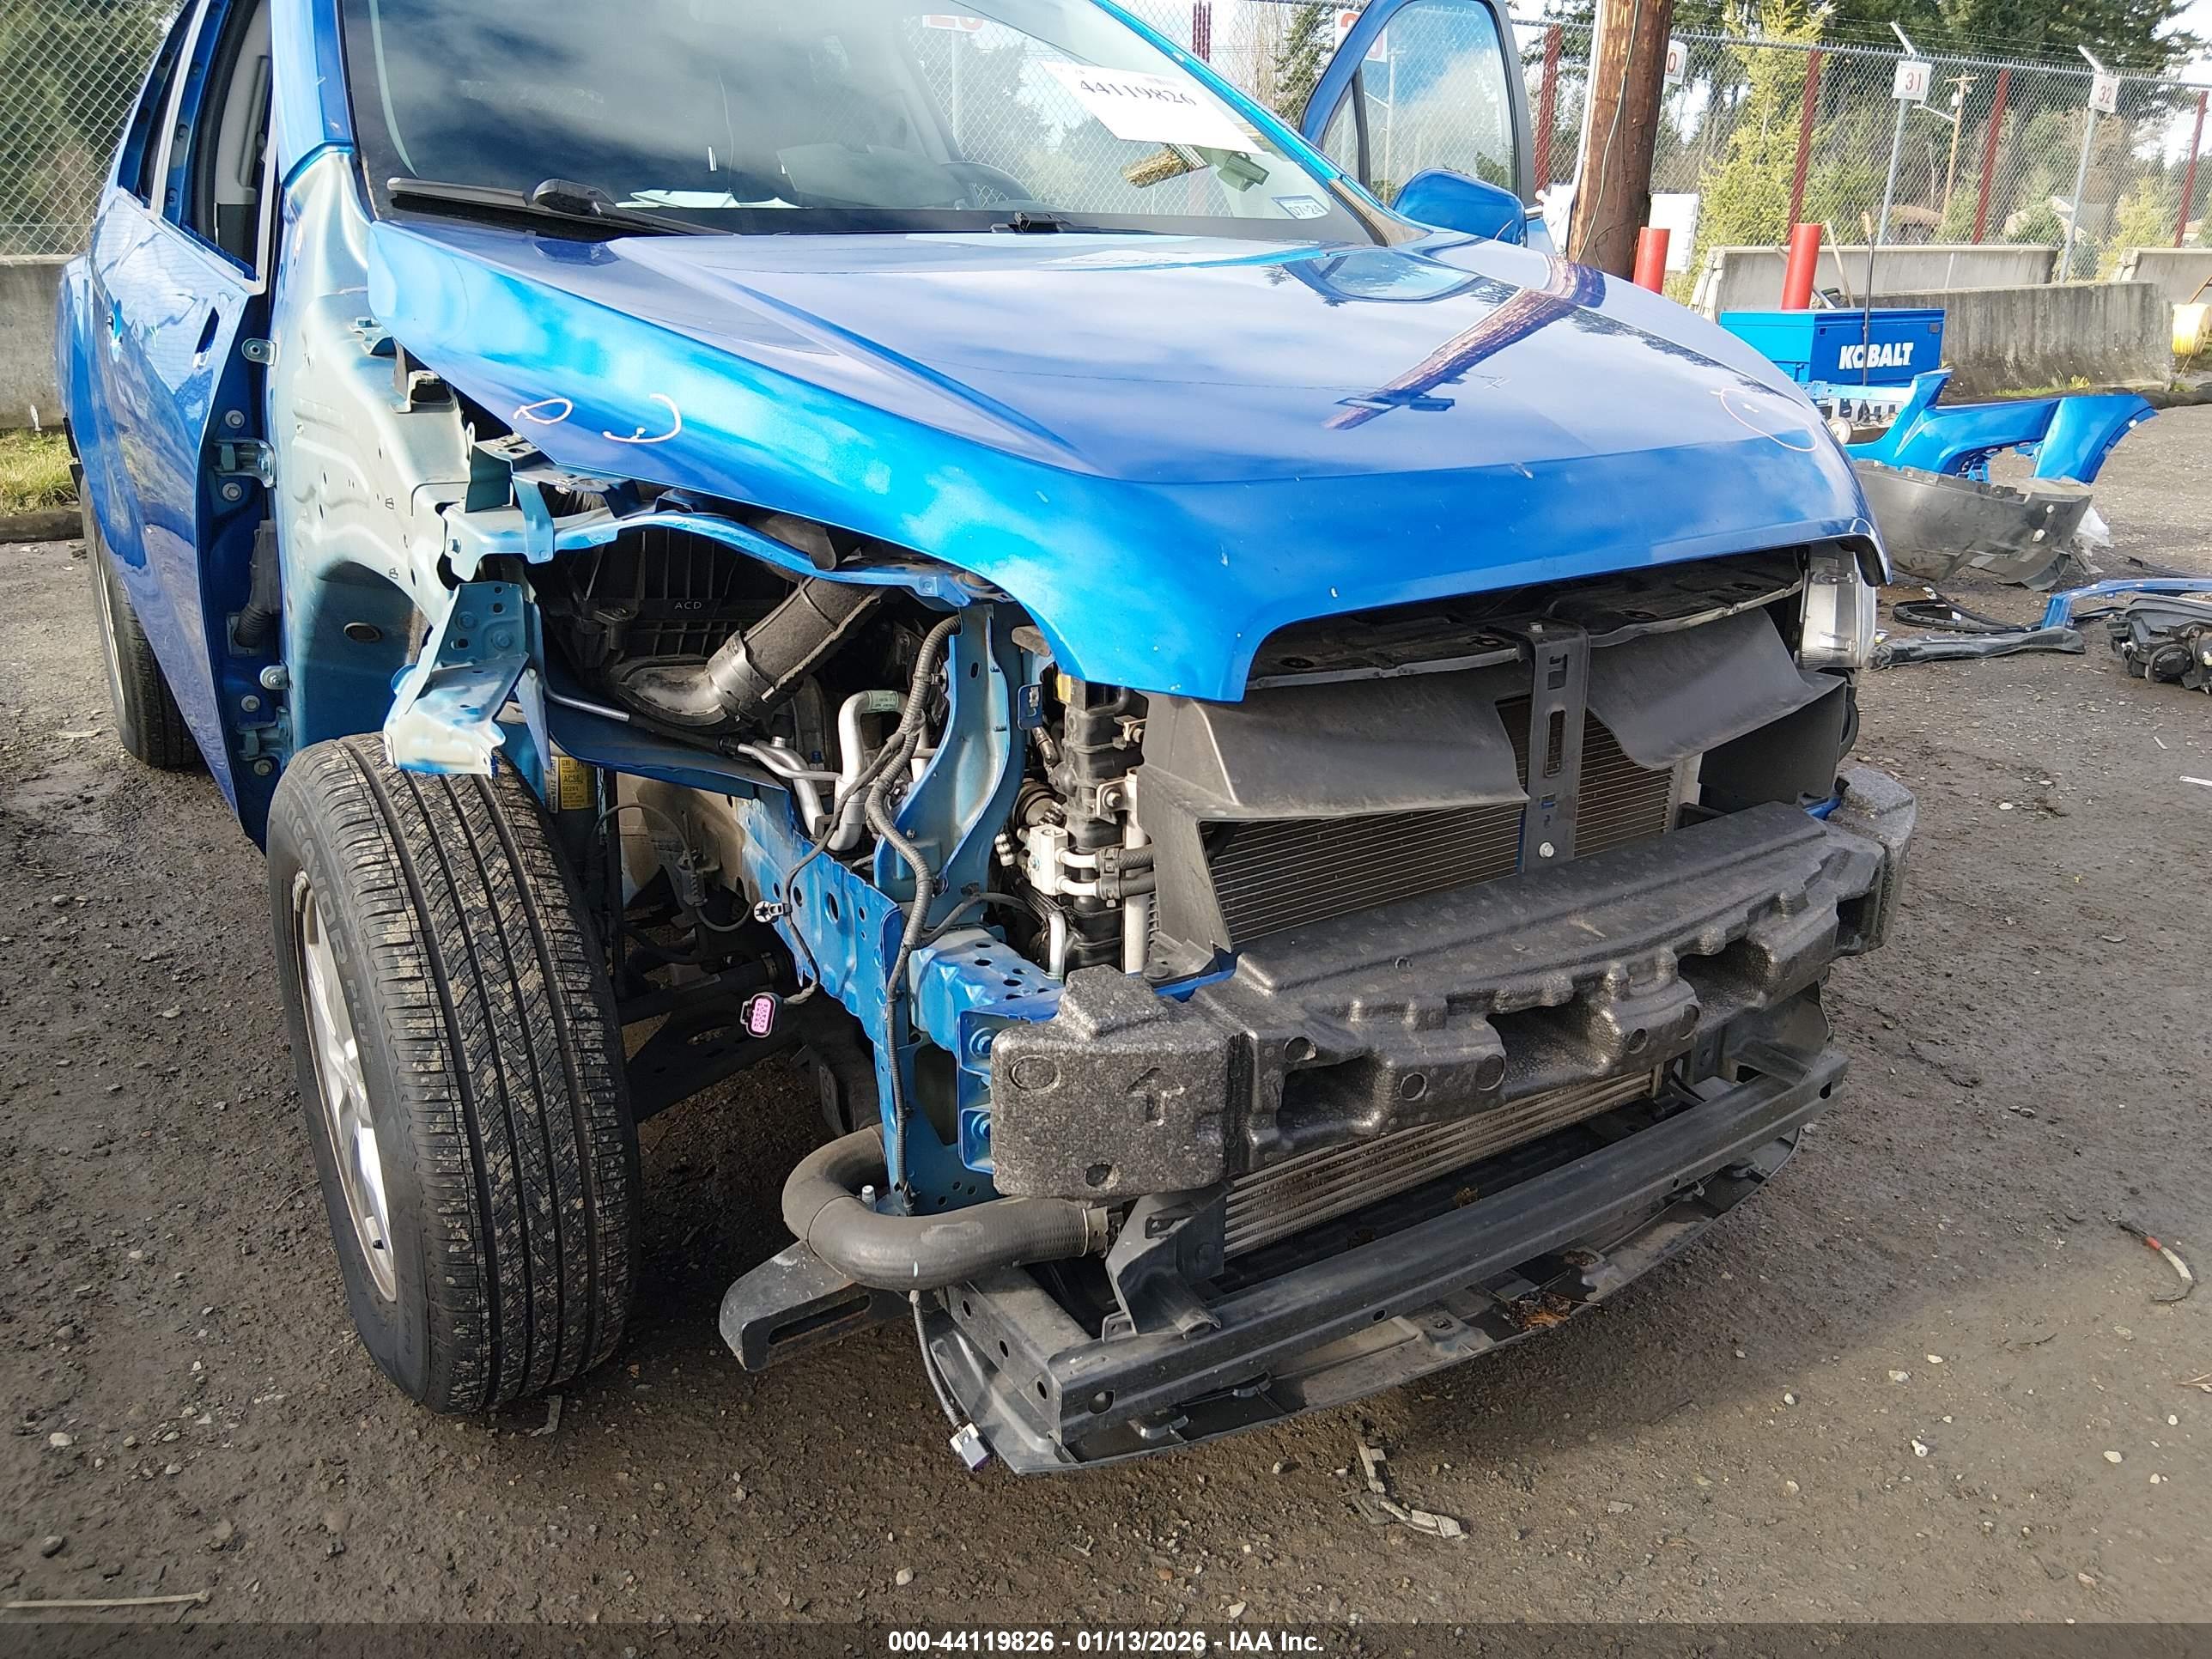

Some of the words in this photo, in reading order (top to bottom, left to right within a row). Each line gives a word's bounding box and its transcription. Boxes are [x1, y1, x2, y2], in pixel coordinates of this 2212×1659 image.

[1080, 80, 1196, 106] 44119826
[1905, 72, 1922, 92] 31
[2099, 85, 2112, 104] 32
[1838, 342, 1914, 370] KOBALT
[674, 601, 702, 610] ACD
[347, 979, 373, 1066] PLUS
